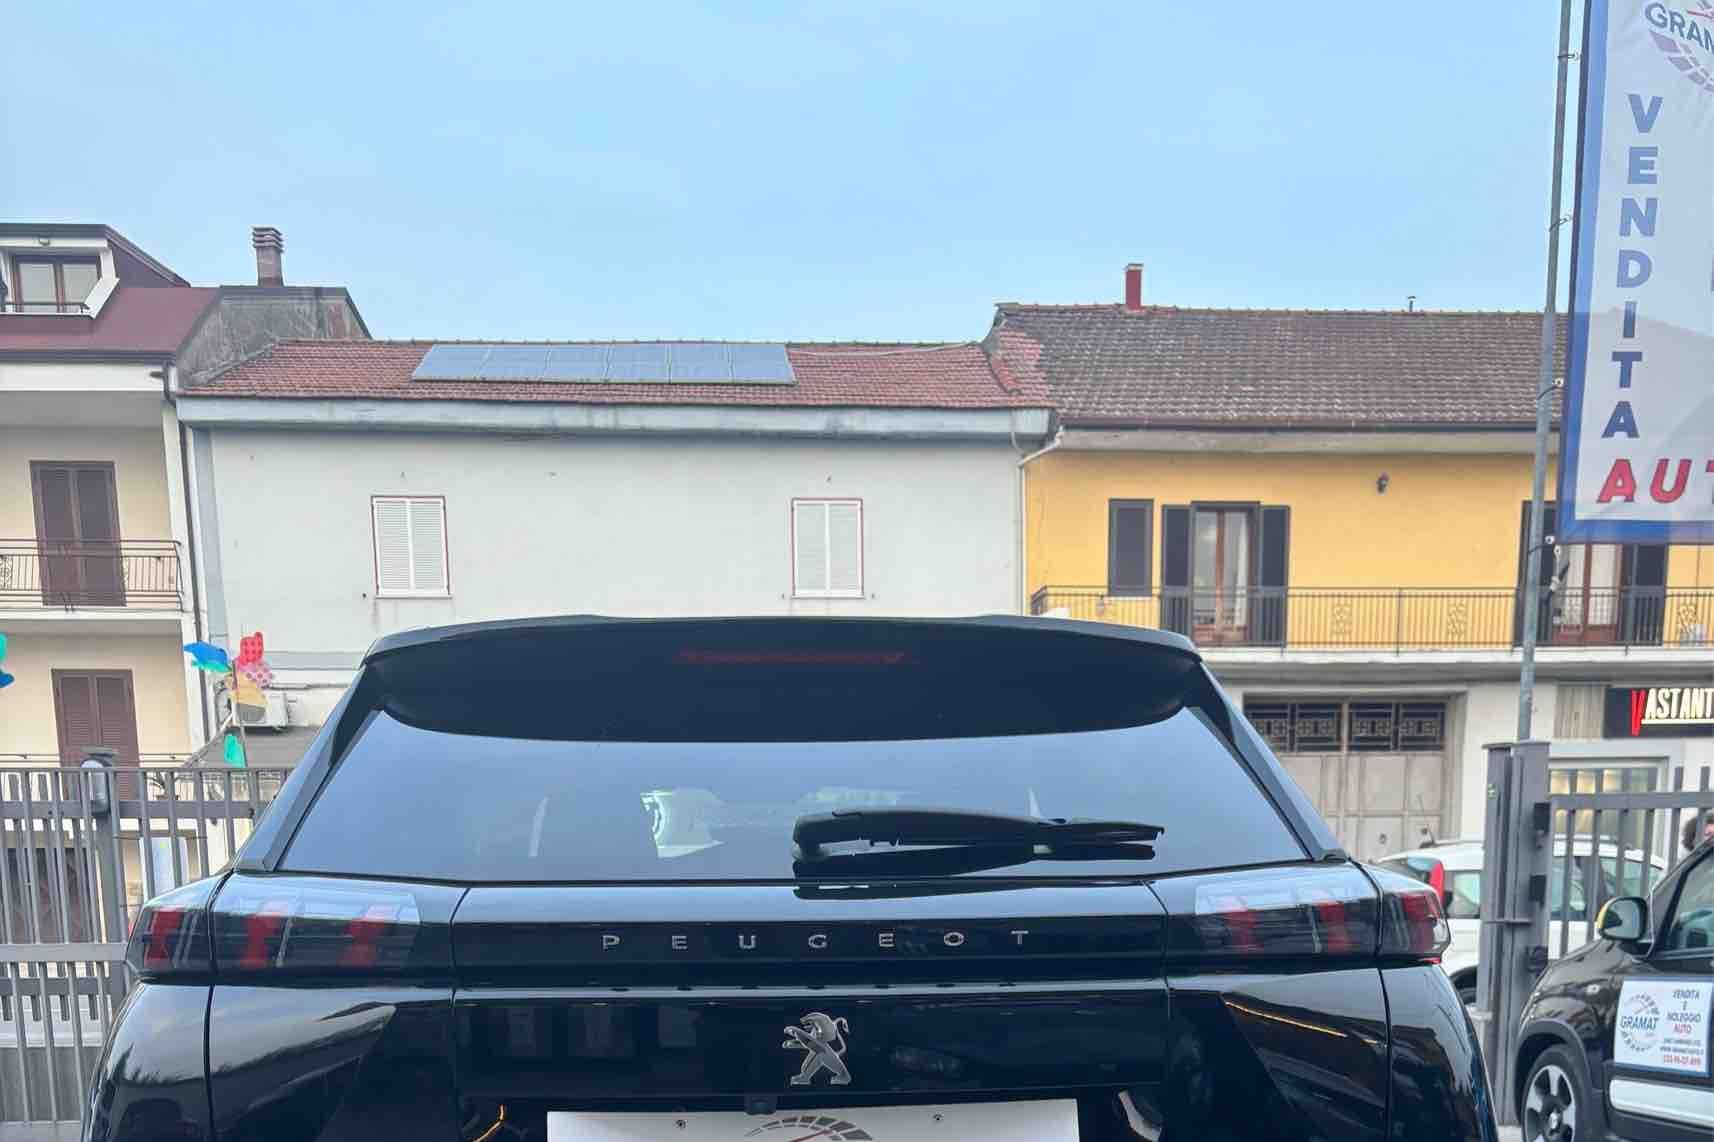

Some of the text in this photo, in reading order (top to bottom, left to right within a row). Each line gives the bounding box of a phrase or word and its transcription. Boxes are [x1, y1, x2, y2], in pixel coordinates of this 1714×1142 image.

[1601, 93, 1663, 439] VENDITA
[1595, 458, 1714, 504] AU
[1631, 688, 1714, 737] VASTANT
[602, 929, 1029, 950] PEUGEOT
[1620, 1015, 1660, 1031] GRAMAT
